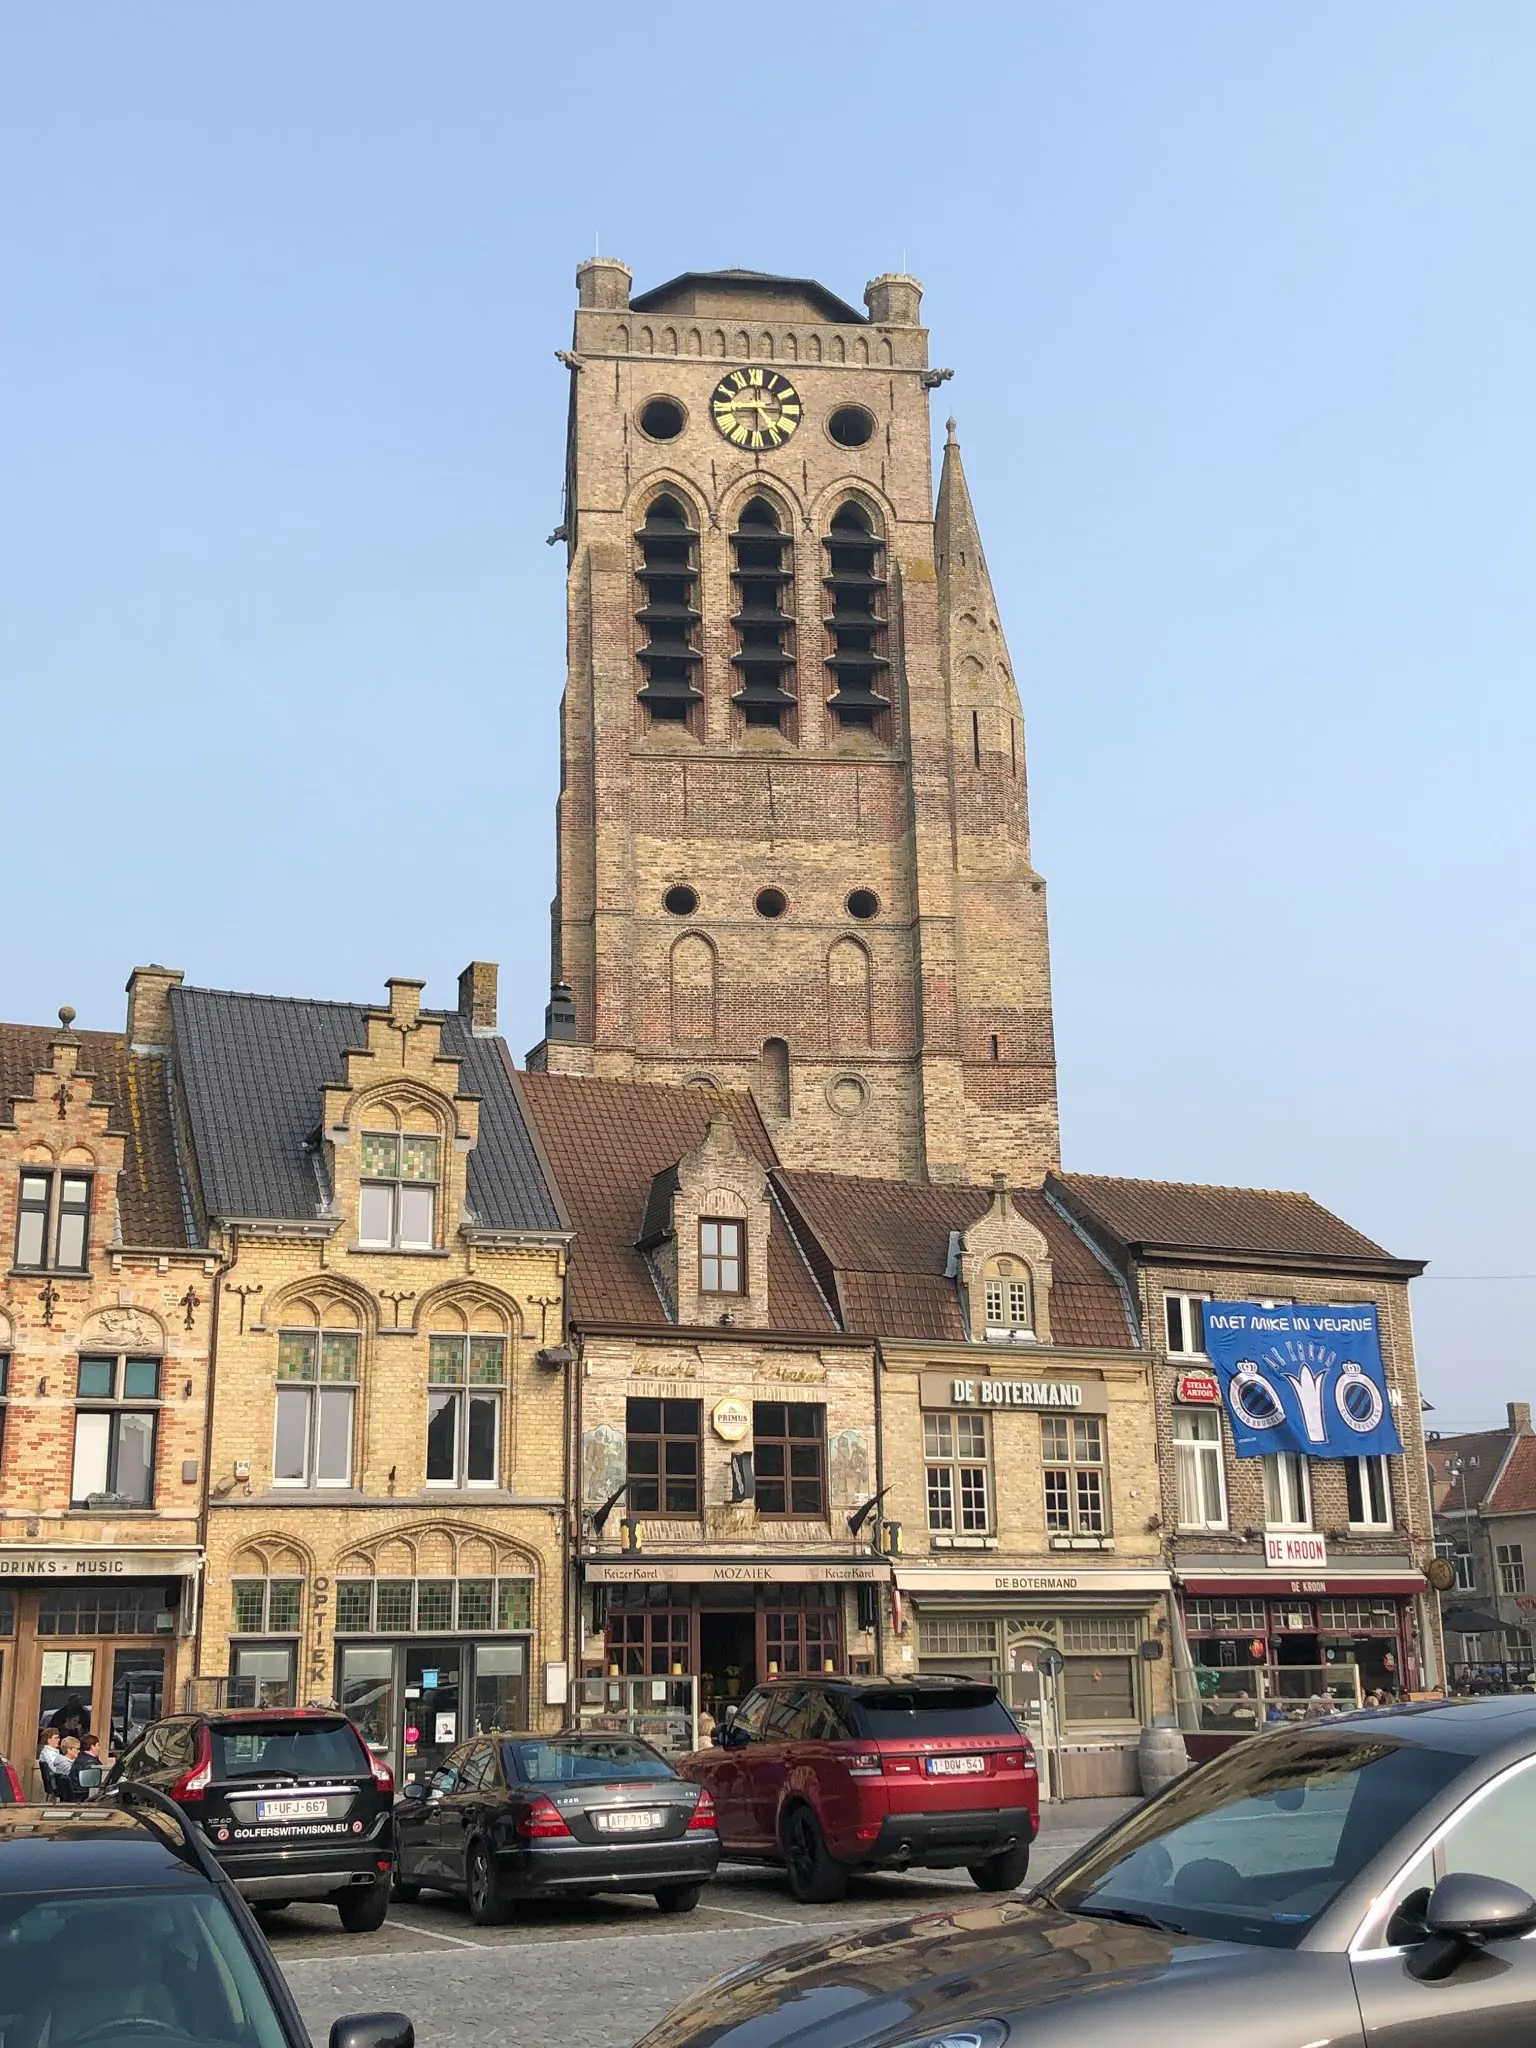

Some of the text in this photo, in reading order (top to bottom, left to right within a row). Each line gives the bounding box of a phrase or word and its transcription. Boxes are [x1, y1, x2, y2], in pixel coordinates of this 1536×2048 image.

[1210, 1315, 1373, 1331] MET MIKE IN VEURNE
[953, 1379, 1082, 1406] DE BOTERMAND
[717, 1414, 748, 1422] PRIMUS
[1268, 1540, 1324, 1560] DE KROON
[0, 1560, 123, 1573] DRINKS MUSIC
[712, 1568, 773, 1579] MOZAIEK
[994, 1578, 1077, 1588] DE BOTERMAND
[1290, 1581, 1327, 1592] DE KROON
[311, 1576, 330, 1682] OPTIEK
[960, 1740, 1000, 1748] ROVER
[233, 1823, 349, 1839] GOLFERSWITHVISION.EU
